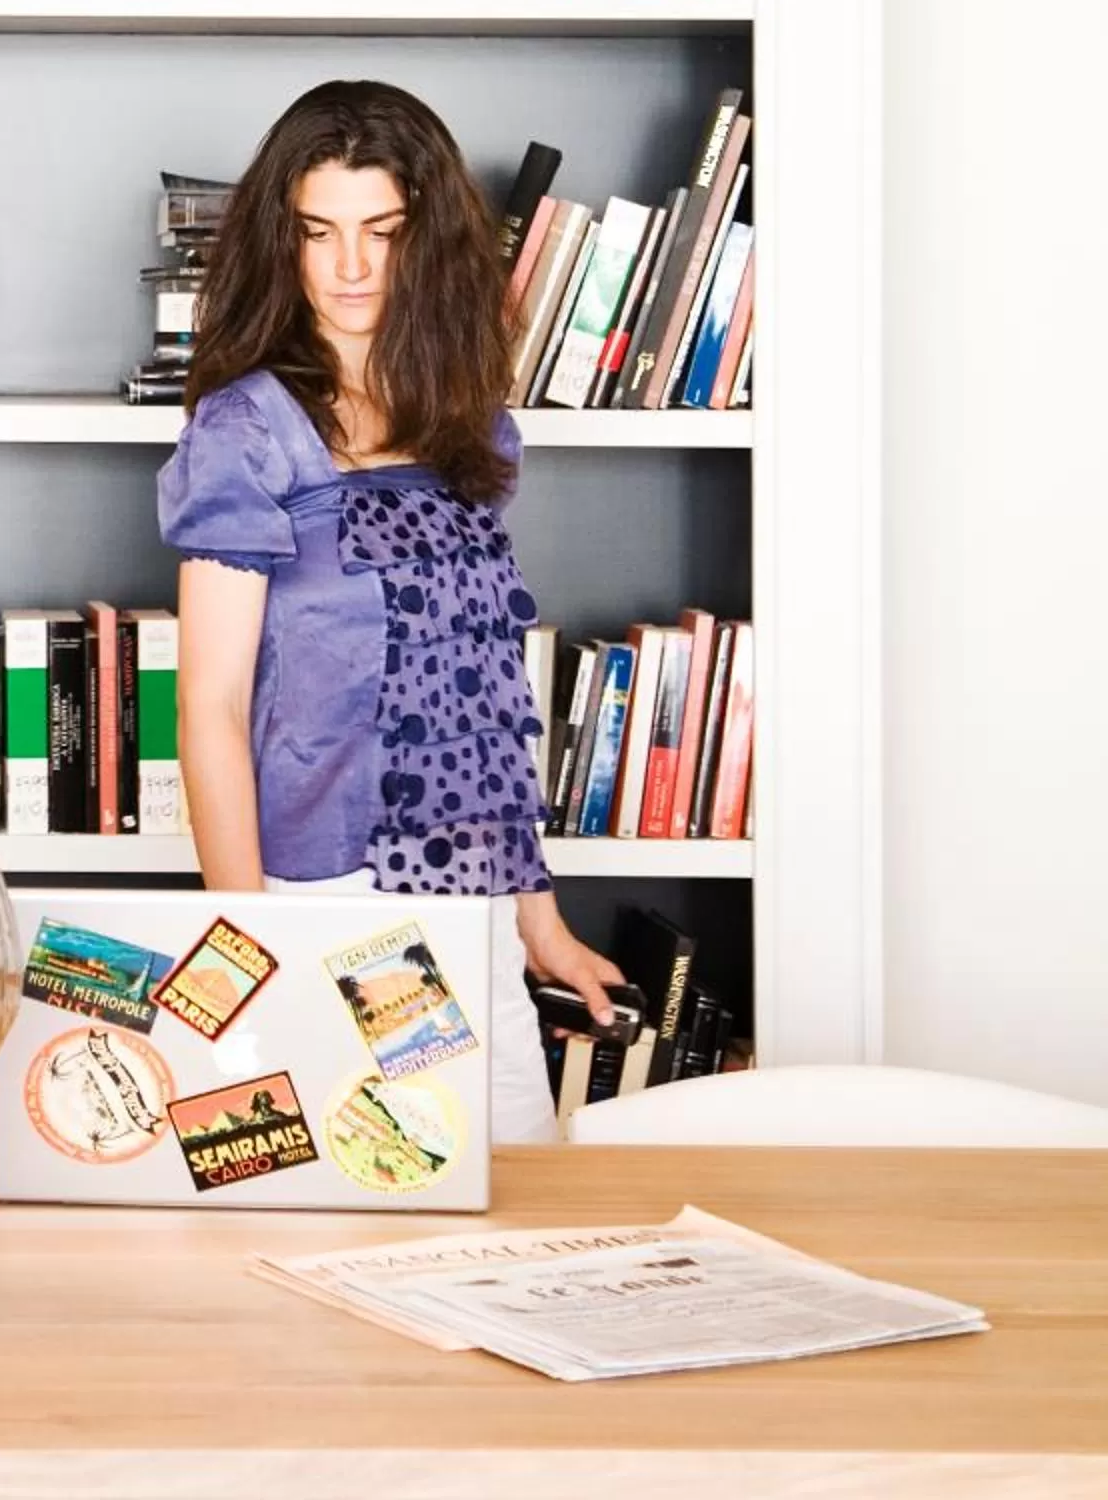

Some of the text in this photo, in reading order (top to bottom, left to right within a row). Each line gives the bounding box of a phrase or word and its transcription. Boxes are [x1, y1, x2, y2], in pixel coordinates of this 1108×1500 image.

[697, 106, 737, 188] WASHINGTON
[212, 922, 269, 969] OXFORD
[27, 970, 151, 1020] HOTEL METROPOLE
[158, 985, 220, 1037] PARIS
[660, 956, 690, 1040] WASHINGTON
[187, 1122, 309, 1174] SEMIRAMIS
[205, 1144, 314, 1186] CAIRO HOTEL
[315, 1229, 663, 1276] FINANCIAL TIMES
